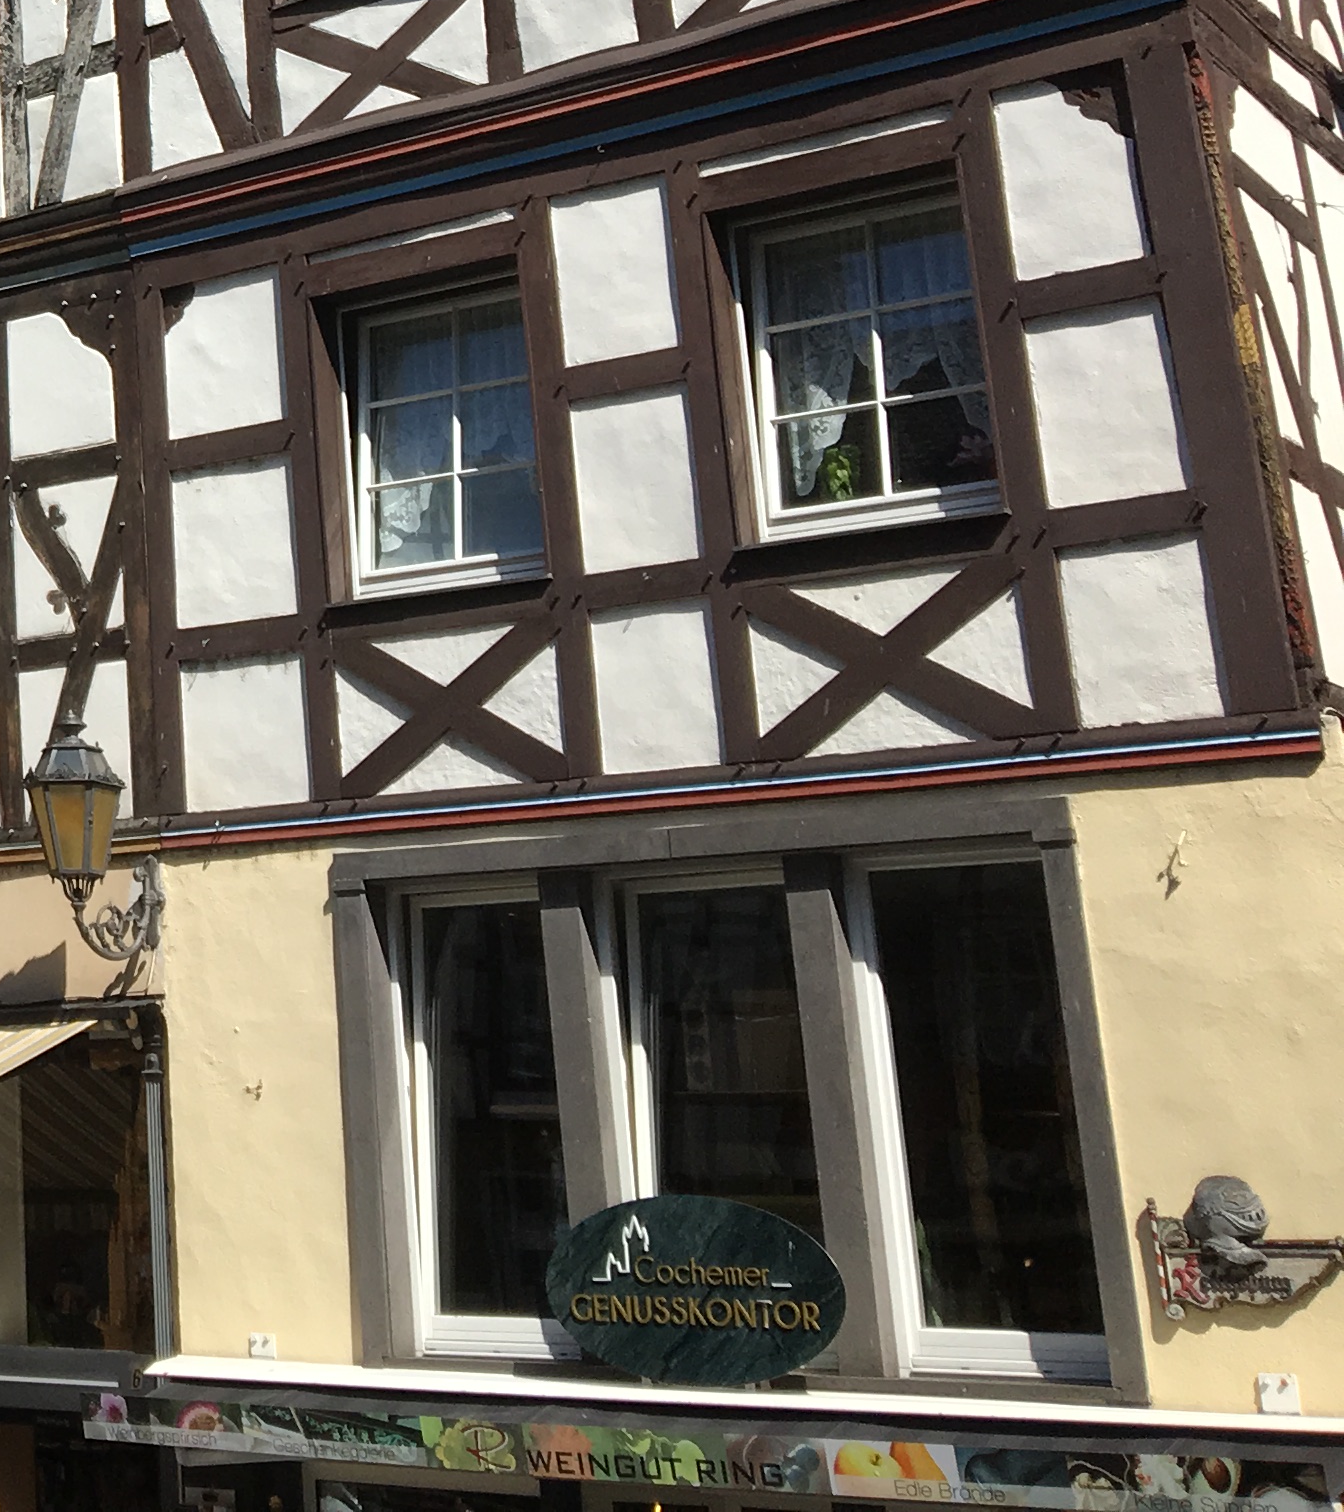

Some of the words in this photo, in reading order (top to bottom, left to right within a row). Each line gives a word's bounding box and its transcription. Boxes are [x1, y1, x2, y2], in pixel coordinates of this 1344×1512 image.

[634, 1254, 770, 1287] Cochemer
[571, 1292, 821, 1332] GENUSSKONTOR
[133, 1369, 142, 1388] 6
[526, 1449, 683, 1482] WEINGUT
[696, 1457, 786, 1488] RING
[893, 1479, 933, 1498] Edle
[1134, 1491, 1192, 1512] Kleine
